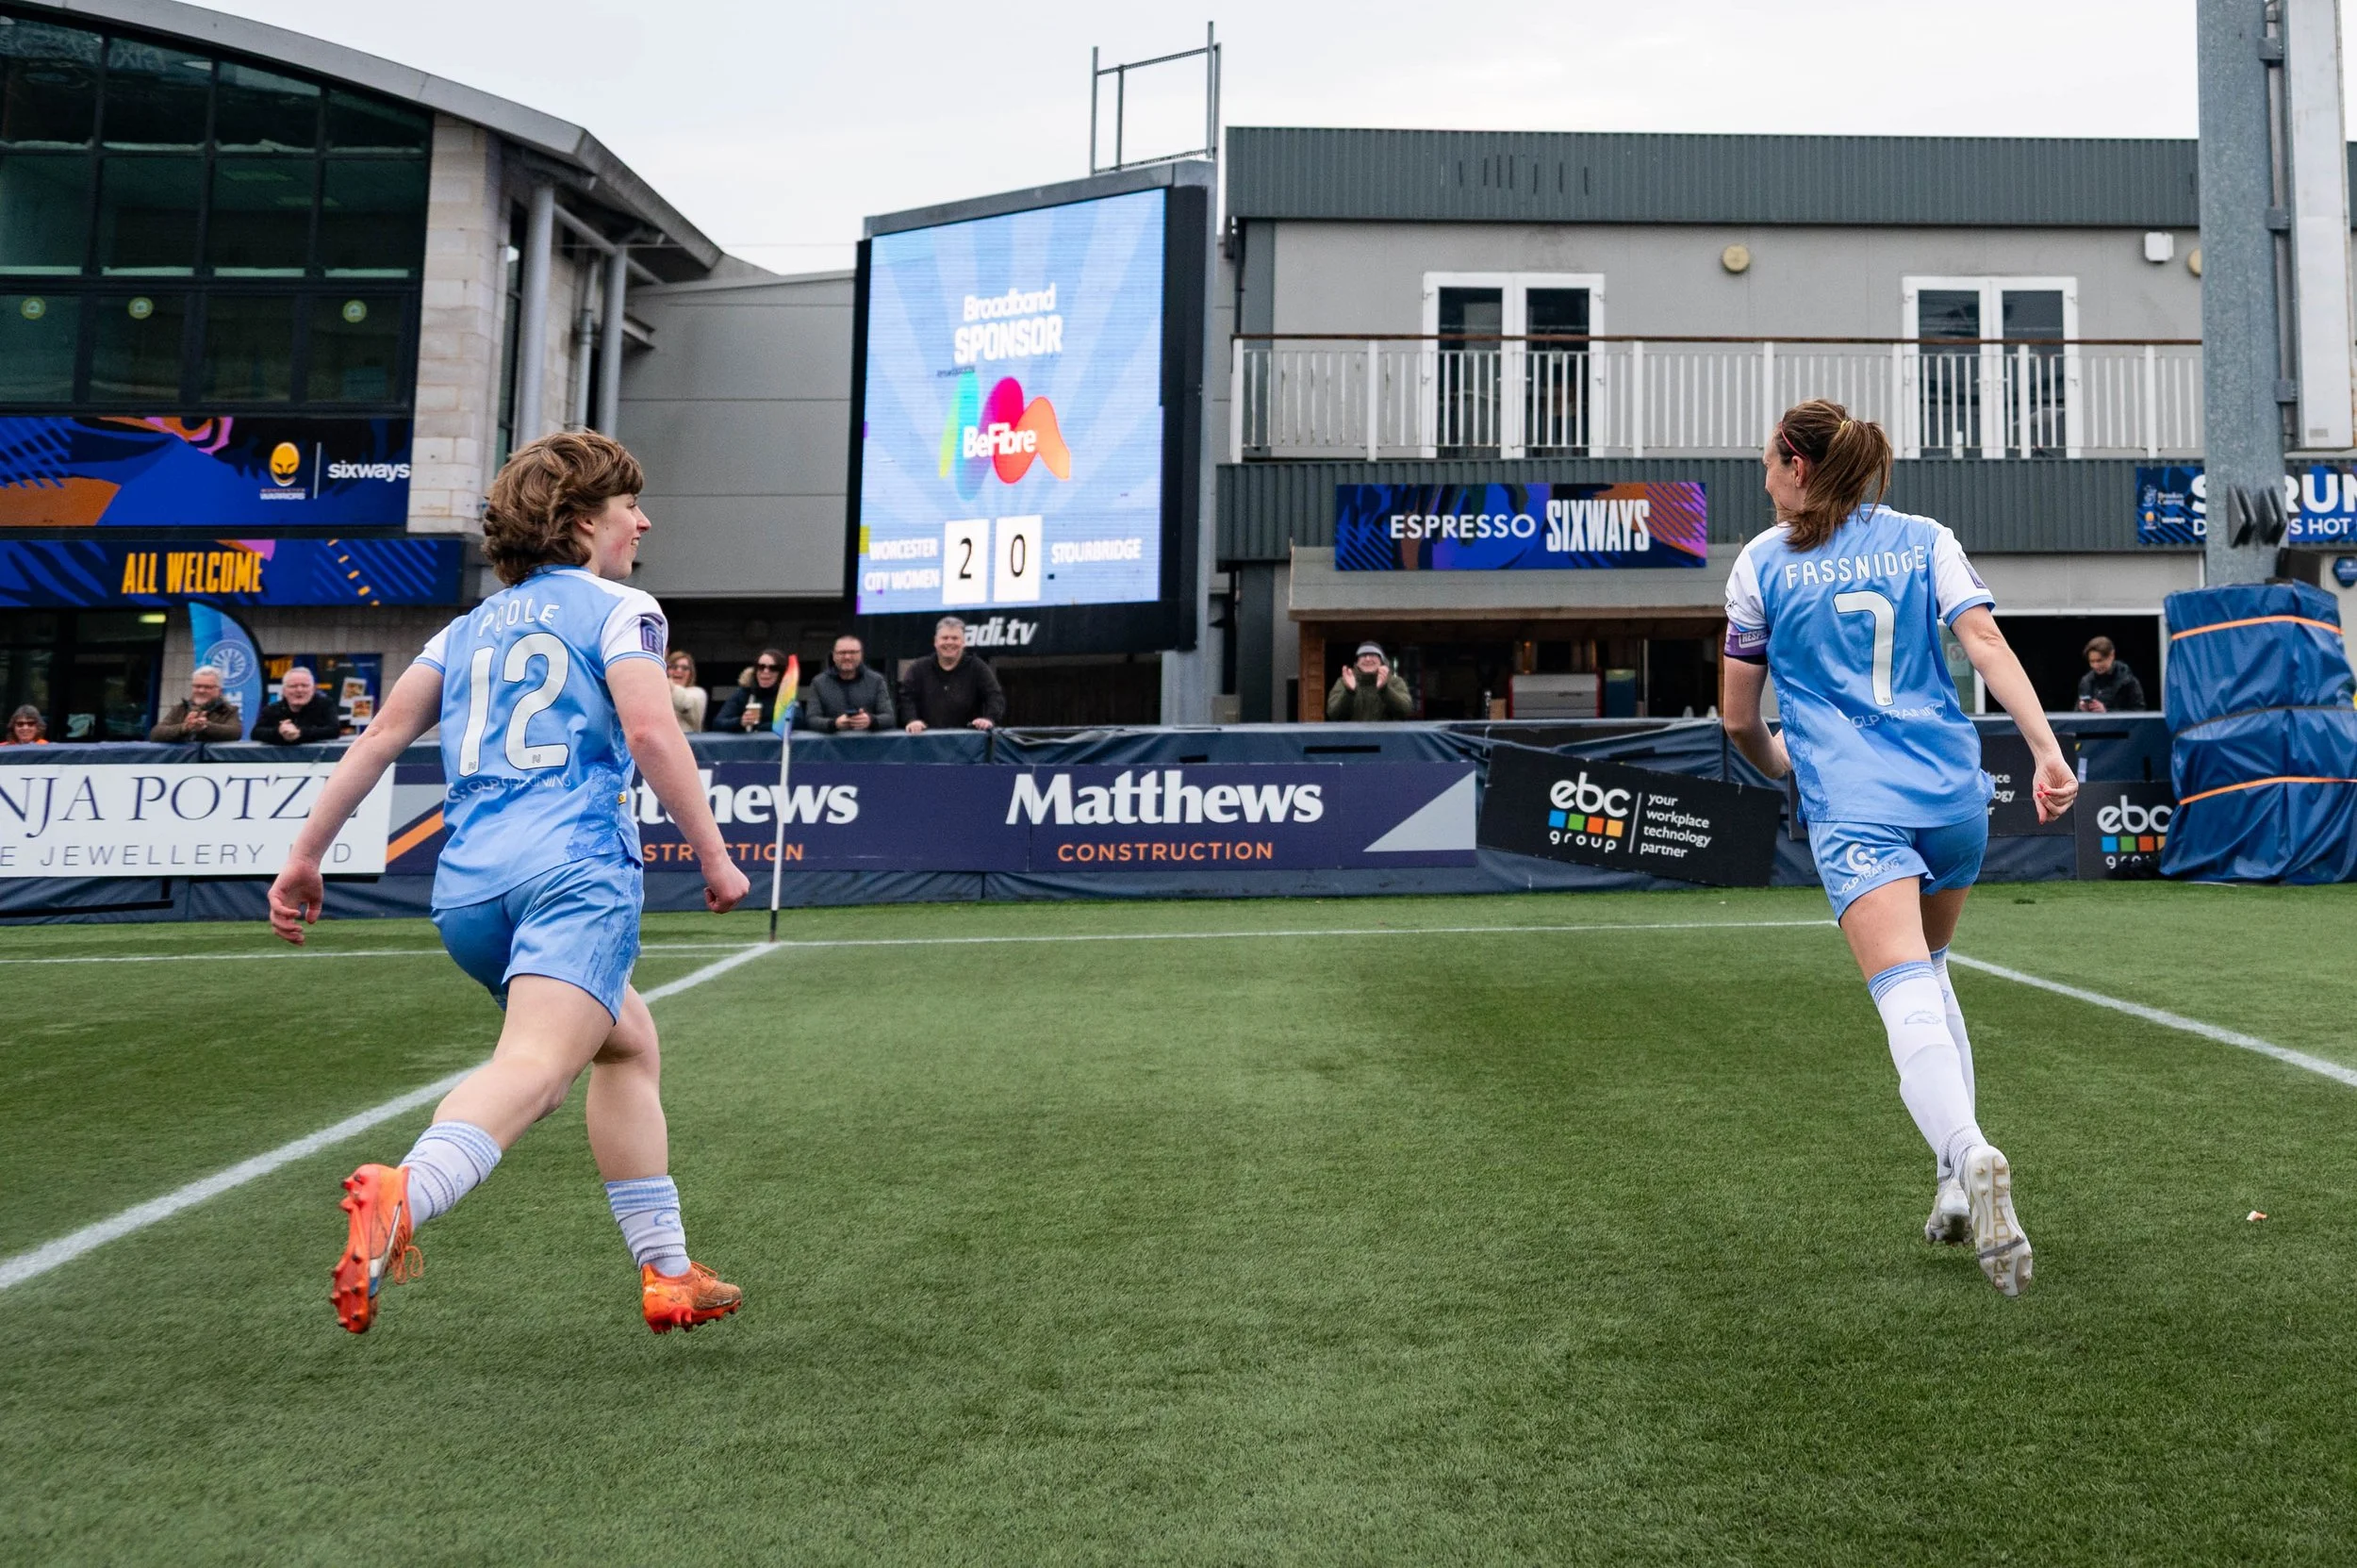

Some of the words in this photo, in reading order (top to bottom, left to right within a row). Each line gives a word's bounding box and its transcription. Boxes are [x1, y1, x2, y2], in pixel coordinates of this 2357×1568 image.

[964, 282, 1056, 322] Broadband
[954, 315, 1063, 365] SPONSOR
[963, 421, 1037, 458] BeFibre
[327, 459, 410, 483] sixways
[1391, 514, 1536, 539] ESPRESSO
[1546, 500, 1650, 553] SIXWAYS
[2307, 518, 2352, 536] HOT
[869, 538, 938, 561] WORCESTER
[959, 537, 972, 579] 2
[1010, 533, 1026, 578] 0
[1050, 538, 1143, 564] STOURBRIDGE
[122, 553, 158, 593] ALL
[166, 553, 263, 593] WELCOME
[864, 572, 889, 592] CITY
[892, 569, 940, 588] WOMEN
[1785, 545, 1927, 589] FASSNIDGE
[965, 618, 1036, 647] adi.tv
[1833, 590, 1895, 706] 7
[458, 632, 569, 778] 12
[1005, 769, 1323, 825] Matthews
[1550, 771, 1631, 818] ebc
[1648, 793, 1678, 806] your
[1646, 811, 1710, 830] workplace
[2097, 795, 2172, 834] ebc
[1058, 842, 1273, 862] CONSTRUCTION
[1549, 831, 1617, 853] group
[1640, 842, 1688, 859] partner
[1643, 826, 1712, 848] technology
[40, 844, 265, 867] JEWELLERY
